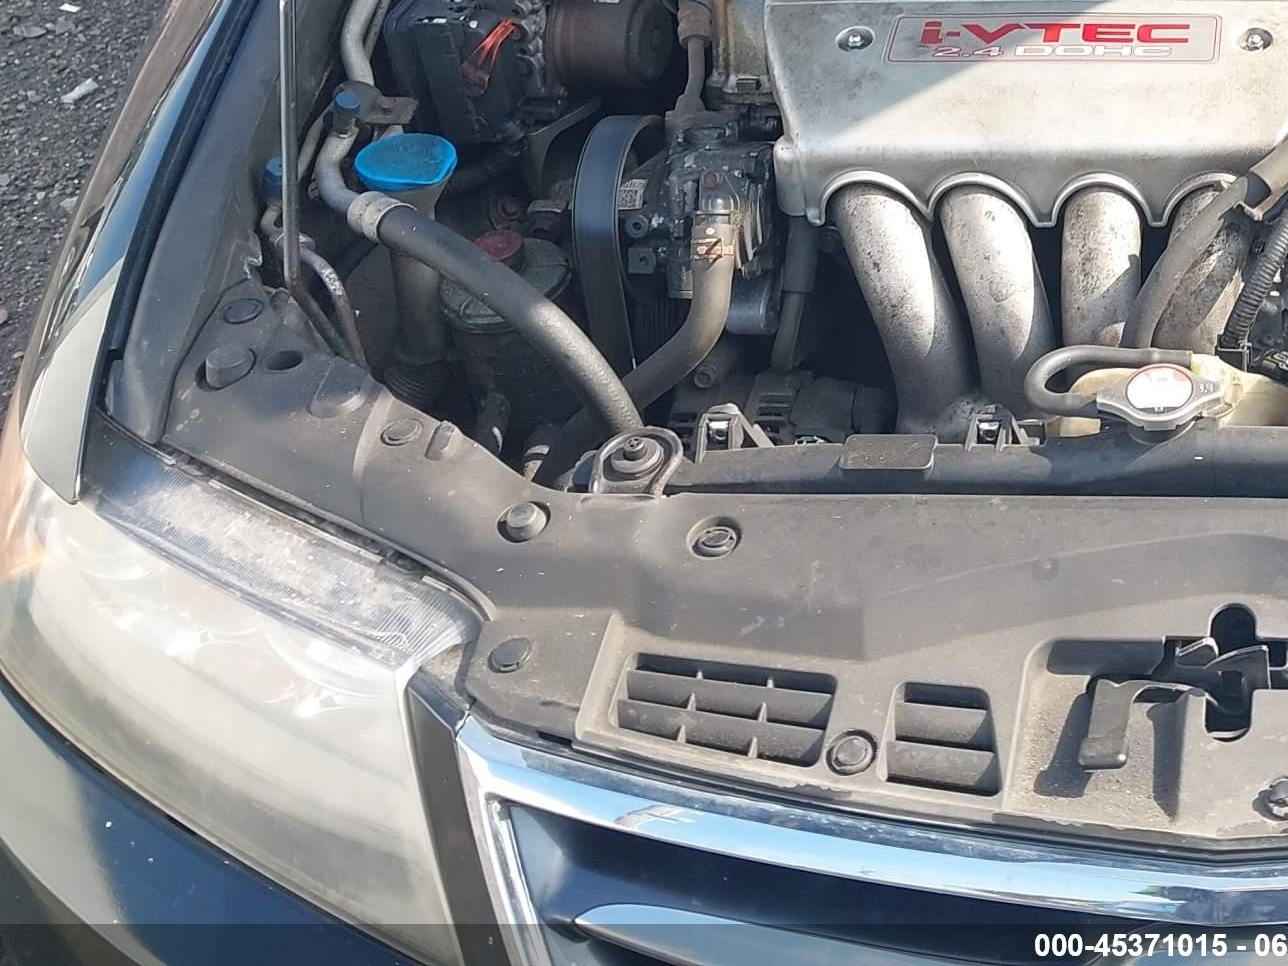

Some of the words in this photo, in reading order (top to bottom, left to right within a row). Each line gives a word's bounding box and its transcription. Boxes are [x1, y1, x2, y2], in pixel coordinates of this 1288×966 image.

[920, 20, 1190, 44] i-VTEC
[932, 45, 1002, 58] 2.4
[1015, 45, 1173, 58] DOHC
